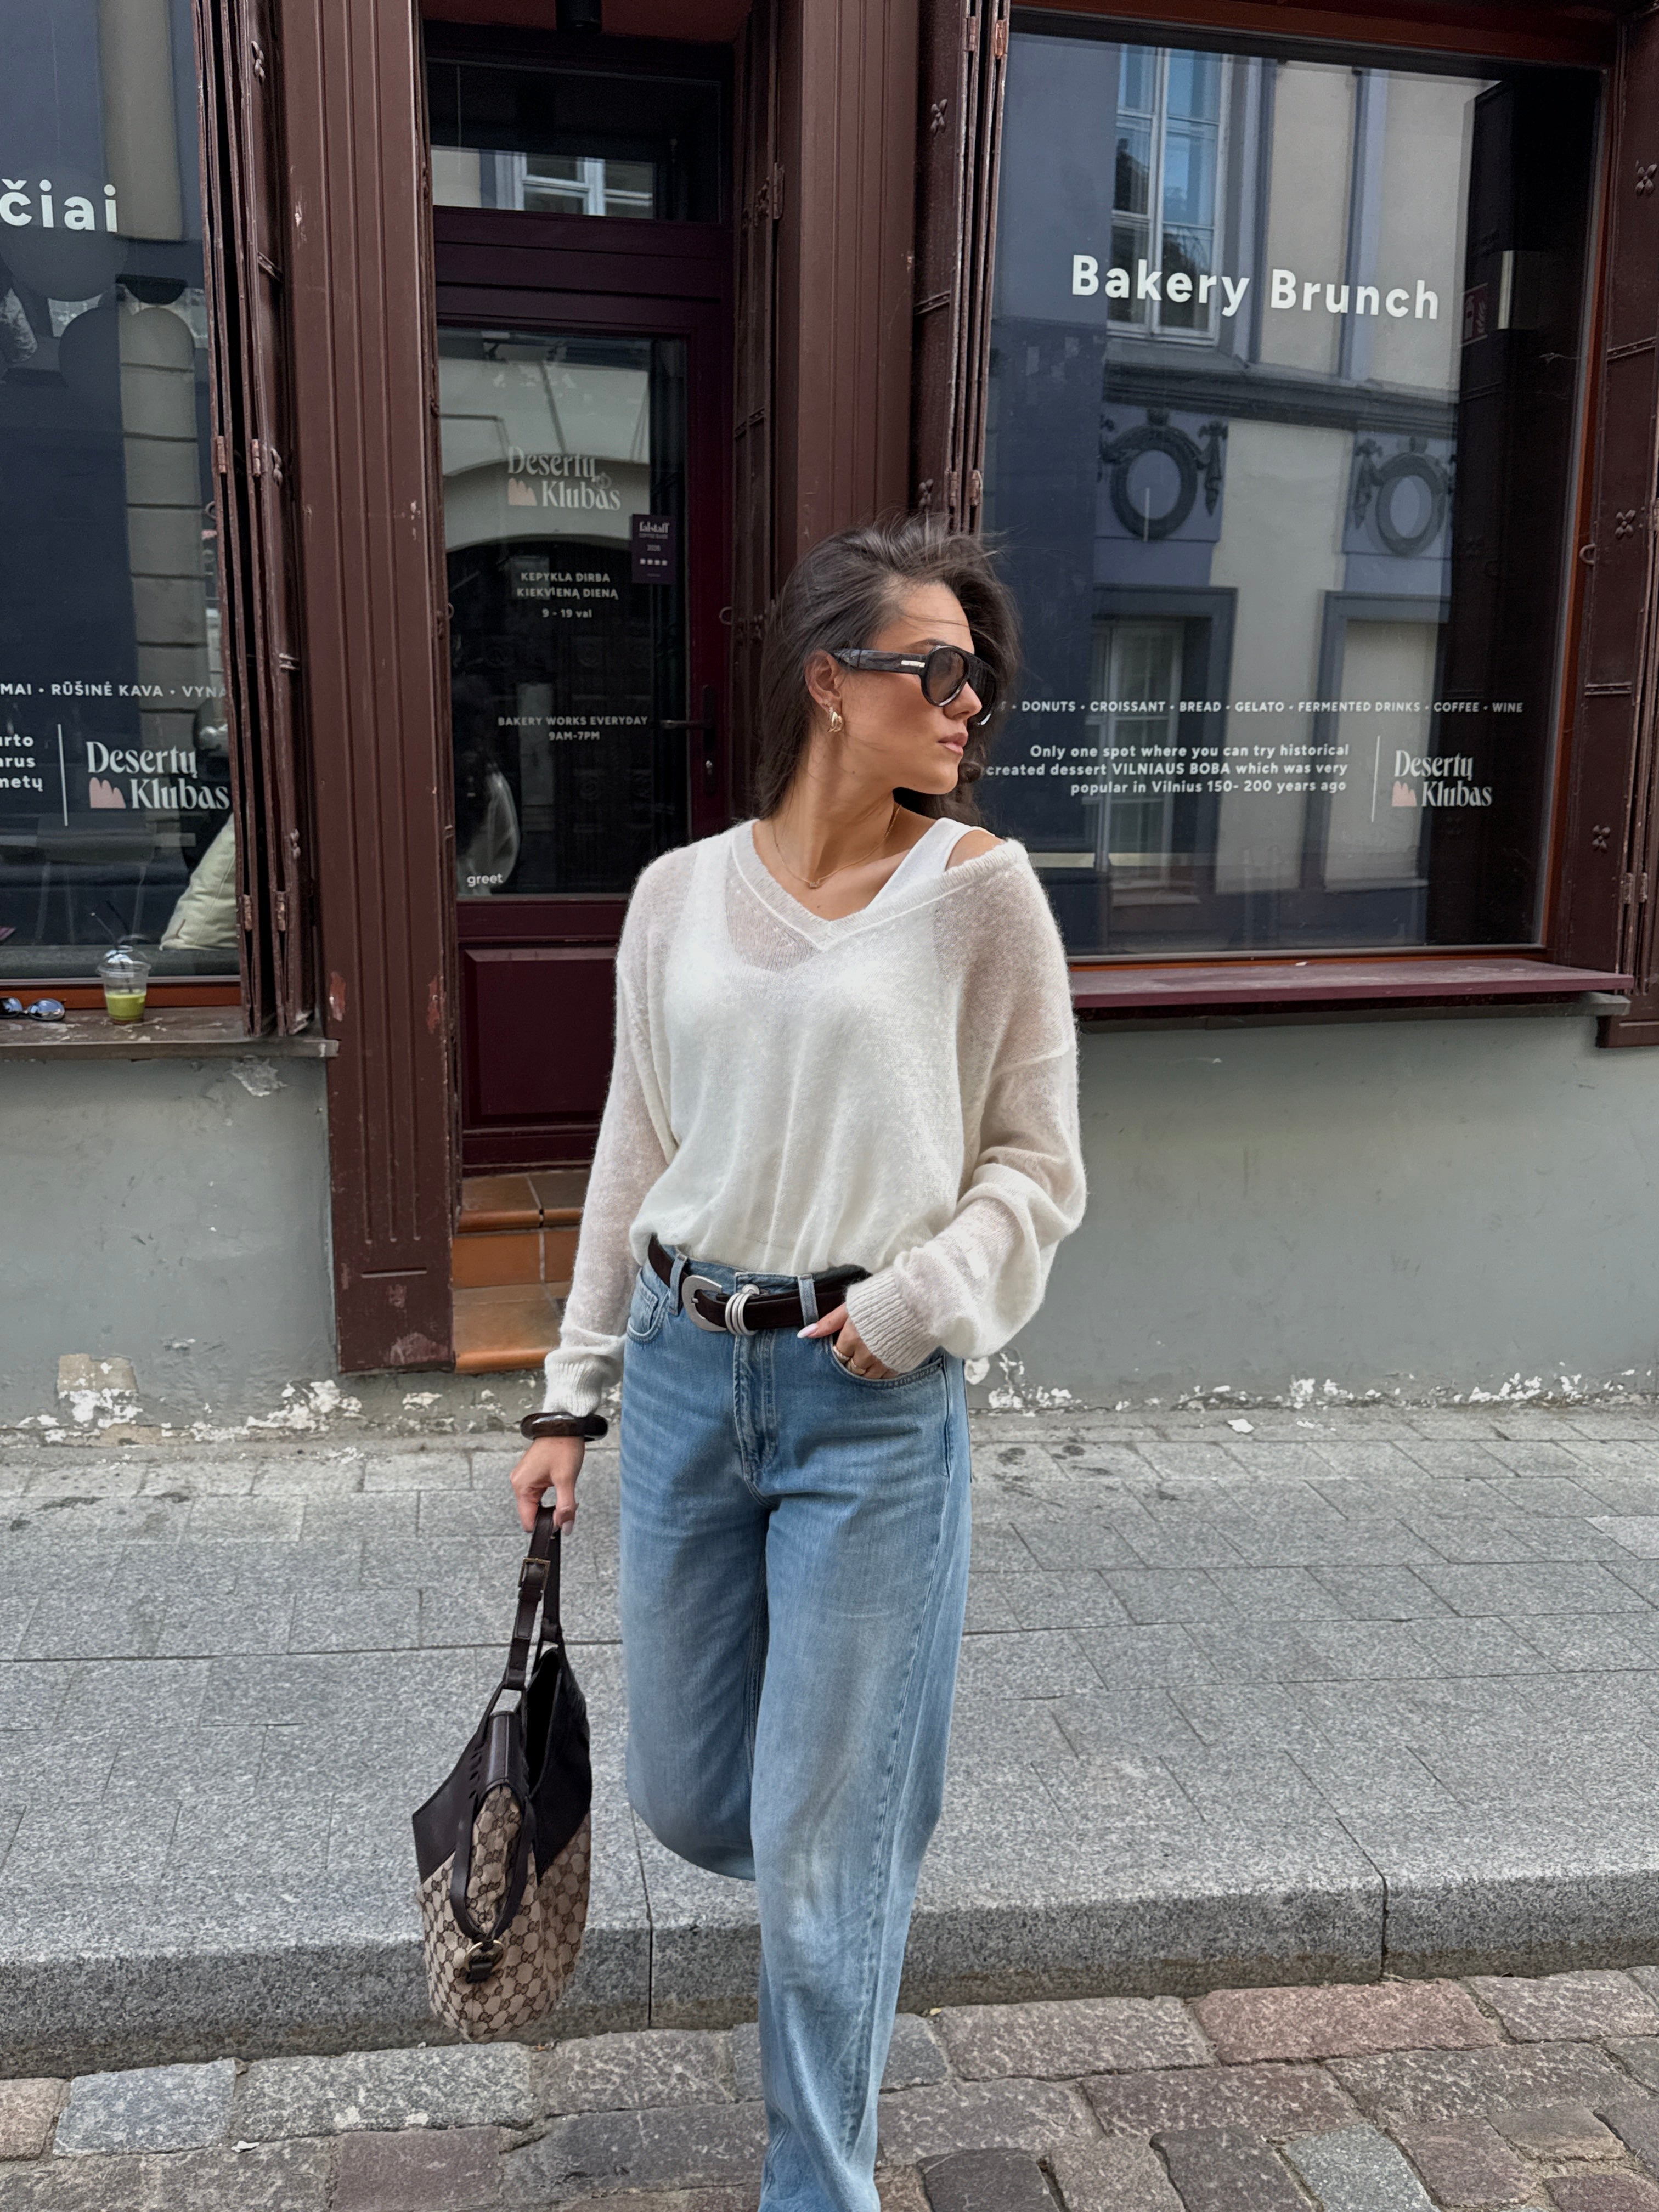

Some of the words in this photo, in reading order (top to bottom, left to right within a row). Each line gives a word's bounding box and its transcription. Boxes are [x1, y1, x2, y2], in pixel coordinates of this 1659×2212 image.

[1073, 255, 1250, 317] Bakery
[1271, 269, 1440, 320] Brunch
[541, 480, 621, 511] Klubas
[521, 572, 573, 583] KEPYKLA
[576, 572, 610, 583] DIRBA
[517, 587, 580, 600] KIEKVIENĄ
[583, 588, 619, 600] DIENĄ
[542, 608, 549, 618] 9
[561, 609, 573, 618] 19
[575, 608, 592, 618] val
[51, 680, 113, 696] RŪŠINĖ
[119, 684, 164, 697] KAVA
[1022, 701, 1076, 713] DONUTS
[1090, 701, 1166, 713] CROISSANT
[1179, 701, 1222, 713] BREAD
[1235, 701, 1285, 713] GELATO
[1298, 701, 1372, 712] FERMENTED
[1375, 702, 1421, 712] DRINKS
[1433, 702, 1479, 712] COFFEE
[1492, 702, 1523, 713] WINE
[498, 716, 543, 726] BAKERY
[546, 716, 587, 726] WORKS
[590, 716, 648, 725] EVERYDAY
[549, 731, 600, 741] 9AM-7PM
[86, 741, 198, 779] Desertų
[1030, 744, 1065, 759] Only
[1070, 748, 1098, 758] one
[1103, 745, 1136, 760] spot
[1141, 744, 1187, 757] where
[1192, 748, 1218, 760] you
[1223, 747, 1248, 757] can
[1254, 745, 1275, 759] try
[1280, 743, 1349, 756] historical
[986, 763, 1044, 776] created
[1050, 763, 1107, 776] dessert
[1112, 763, 1184, 775] VILNIAUS
[1189, 763, 1230, 775] BOBA
[1235, 763, 1279, 775] which
[1284, 764, 1311, 774] was
[1316, 764, 1348, 776] very
[1393, 749, 1474, 781] Desertų
[129, 777, 231, 810] Klubas
[1070, 781, 1128, 797] popular
[1133, 781, 1147, 793] in
[1152, 780, 1203, 793] Vilnius
[1244, 780, 1272, 792] 200
[1277, 782, 1317, 794] years
[1321, 782, 1347, 794] ago
[1421, 780, 1493, 807] Klubas
[466, 873, 504, 888] greet
